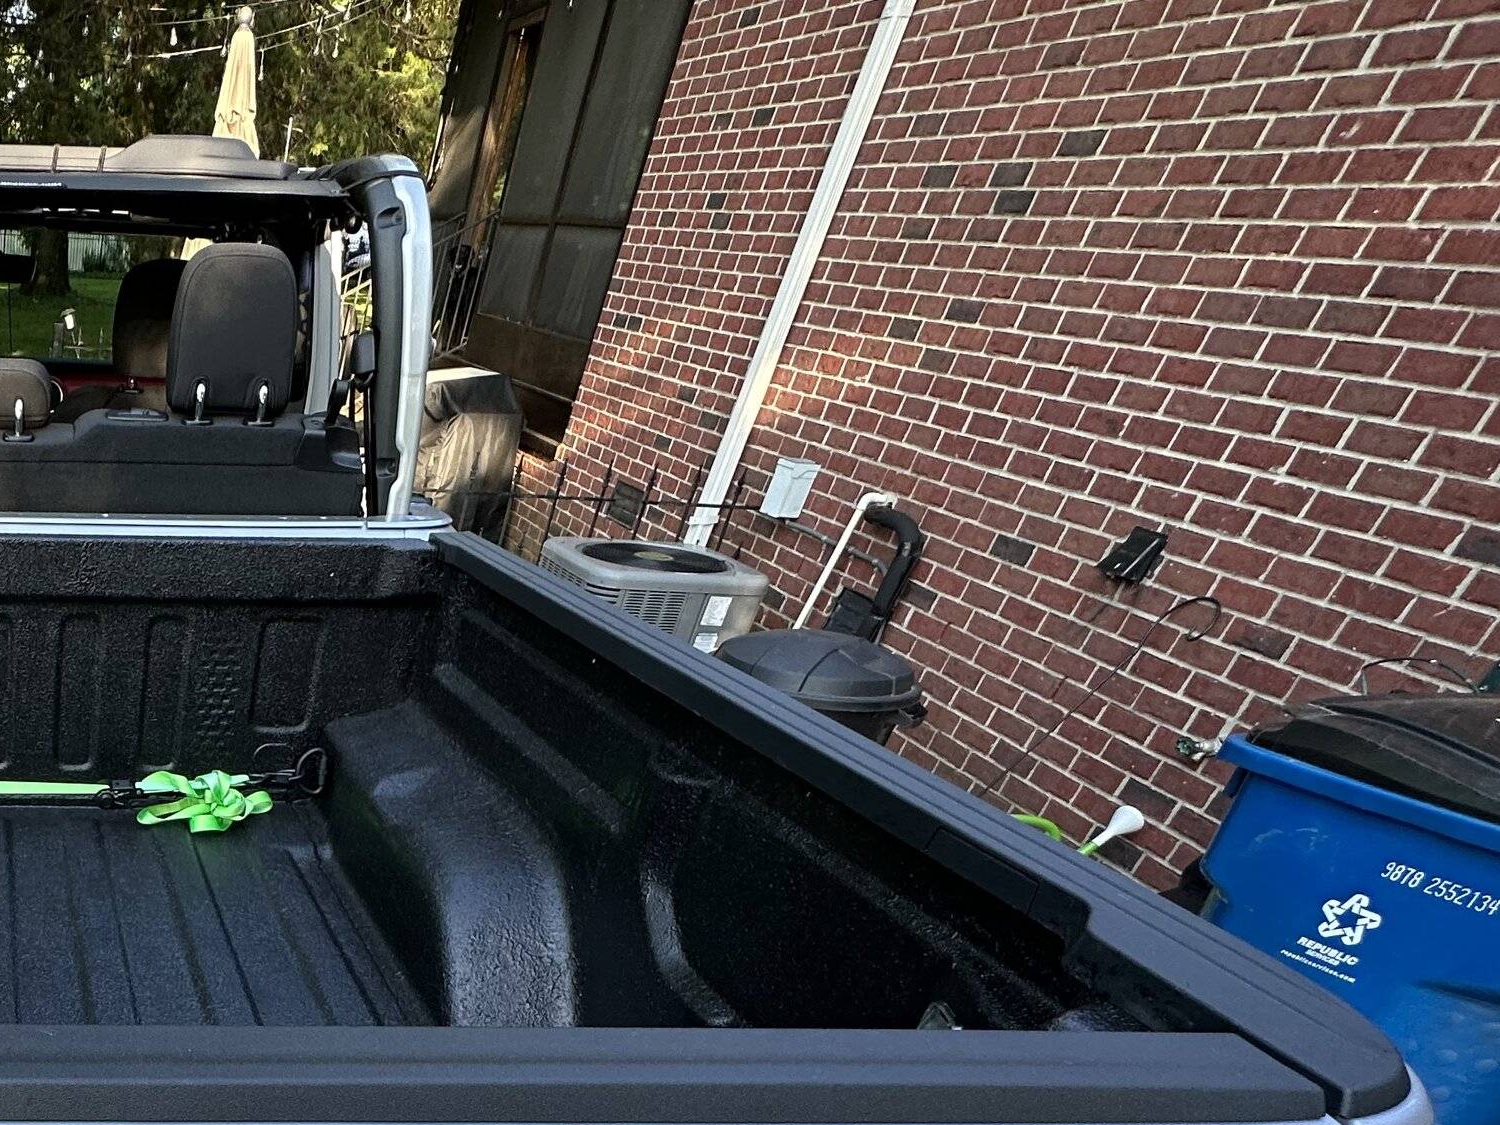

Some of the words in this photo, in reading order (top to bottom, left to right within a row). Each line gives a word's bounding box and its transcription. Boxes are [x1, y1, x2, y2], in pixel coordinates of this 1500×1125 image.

[1380, 861, 1425, 888] 9878
[1423, 877, 1500, 916] 2552134
[1296, 936, 1360, 966] REPUBLIC
